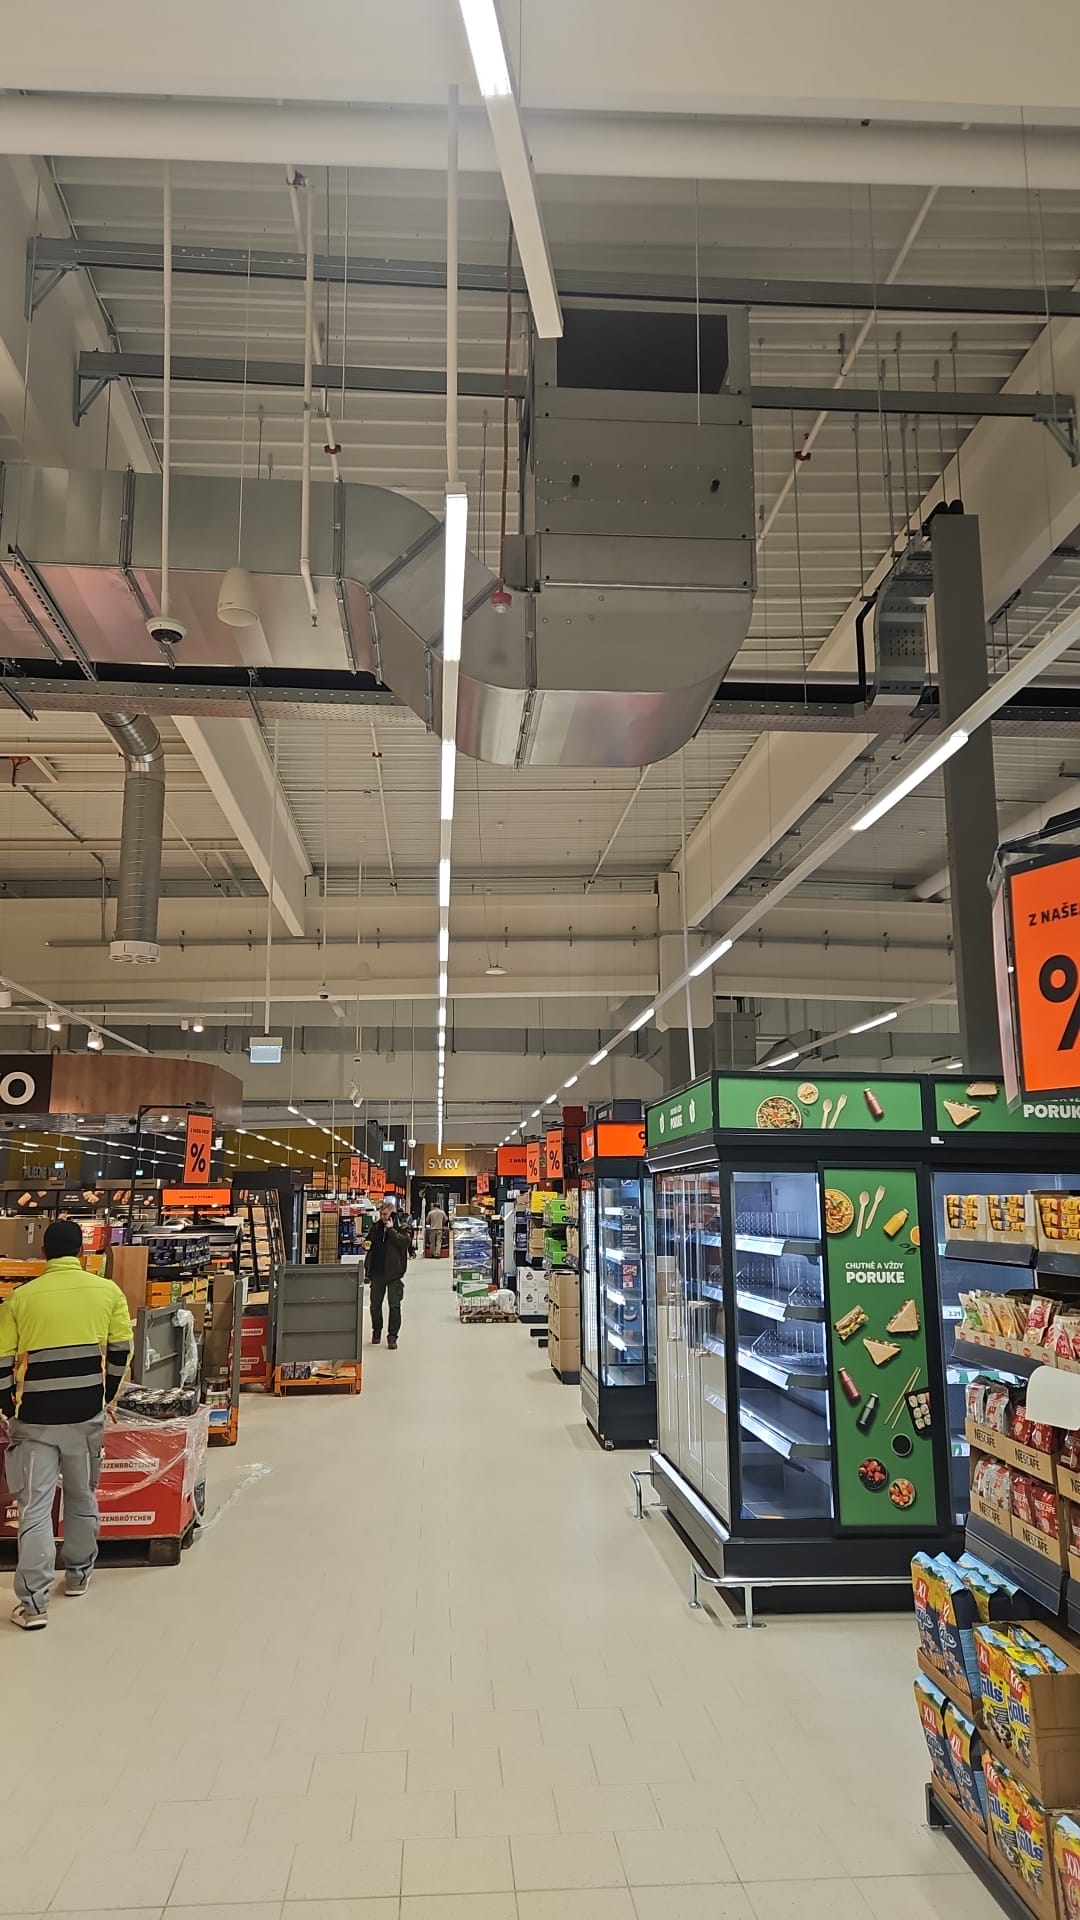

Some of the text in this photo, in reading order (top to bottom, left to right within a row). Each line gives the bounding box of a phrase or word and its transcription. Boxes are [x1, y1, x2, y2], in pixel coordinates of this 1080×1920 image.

[1028, 902, 1080, 927] Z NAŠE
[428, 1158, 461, 1170] SYRY
[845, 1261, 904, 1270] CHUTNÉ A VŽDY
[846, 1271, 905, 1284] PORUKE
[923, 1704, 936, 1729] XXL
